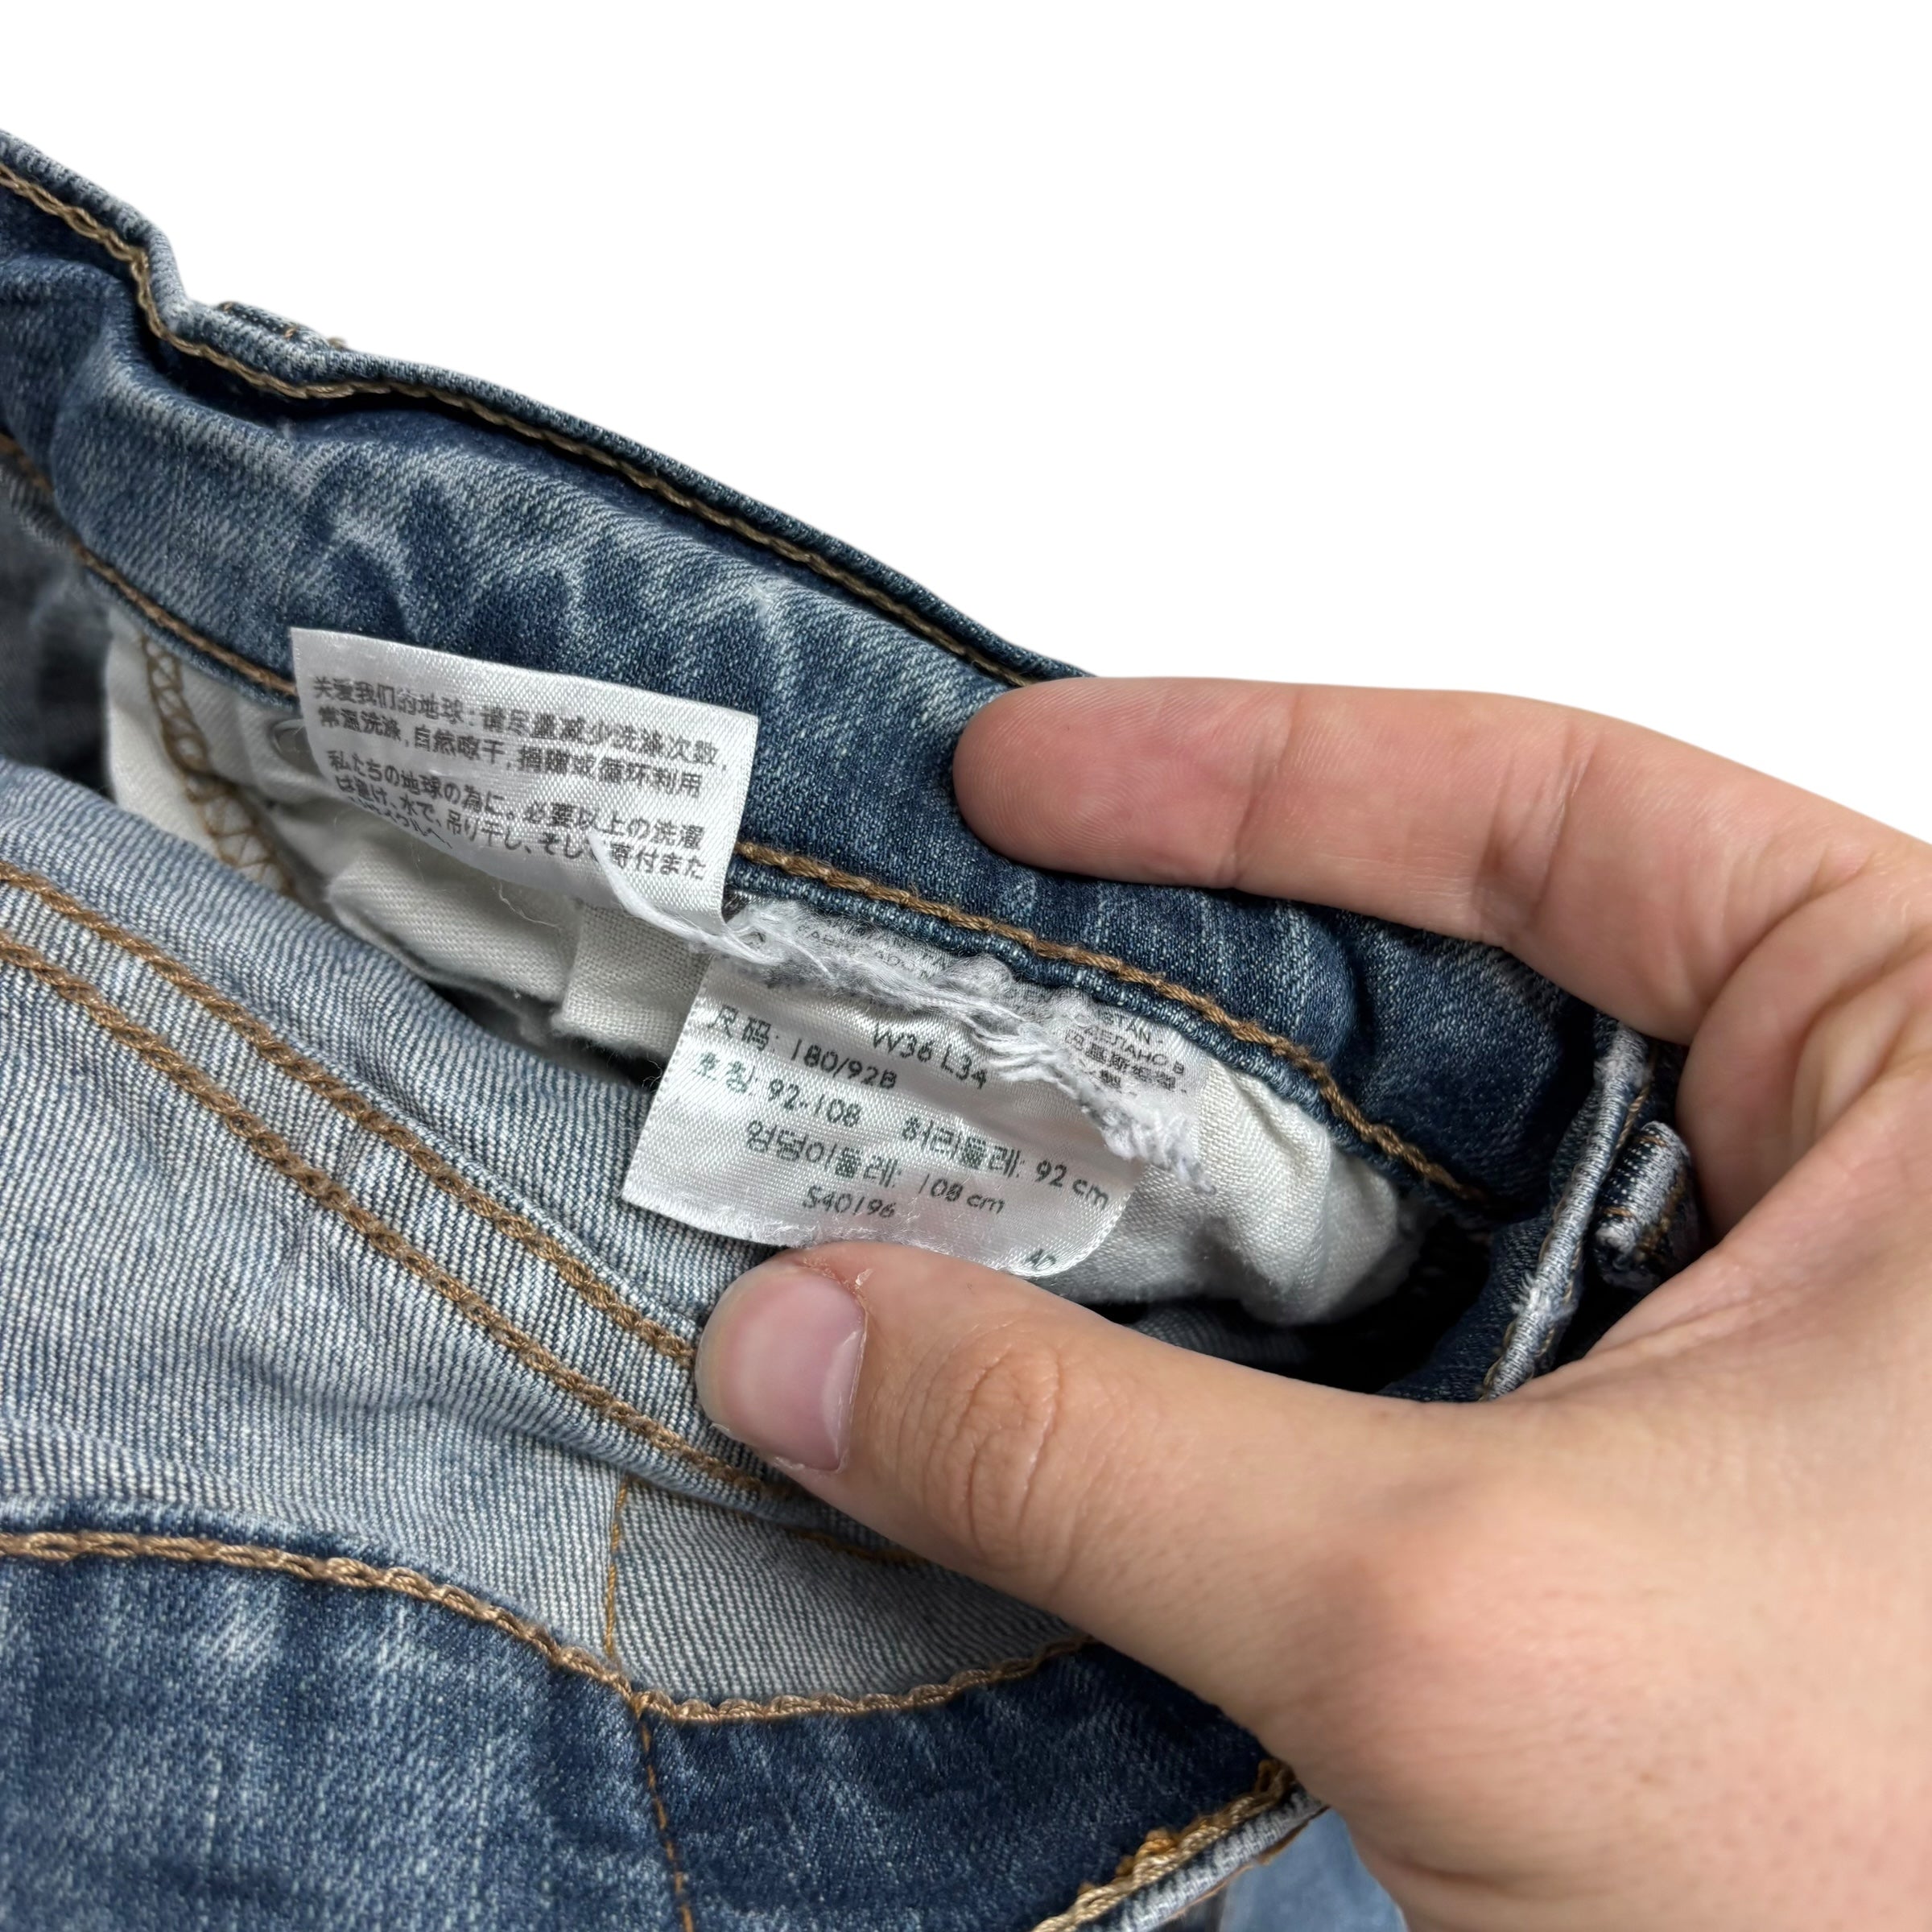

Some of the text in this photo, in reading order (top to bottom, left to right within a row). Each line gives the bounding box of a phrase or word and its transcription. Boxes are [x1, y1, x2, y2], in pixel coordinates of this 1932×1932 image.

[791, 1038, 897, 1089] 180/92B
[873, 1022, 986, 1089] W36 L34
[919, 1174, 963, 1202] 108
[967, 1194, 1005, 1214] cm
[1035, 1159, 1067, 1187] 92
[1072, 1182, 1109, 1207] cm
